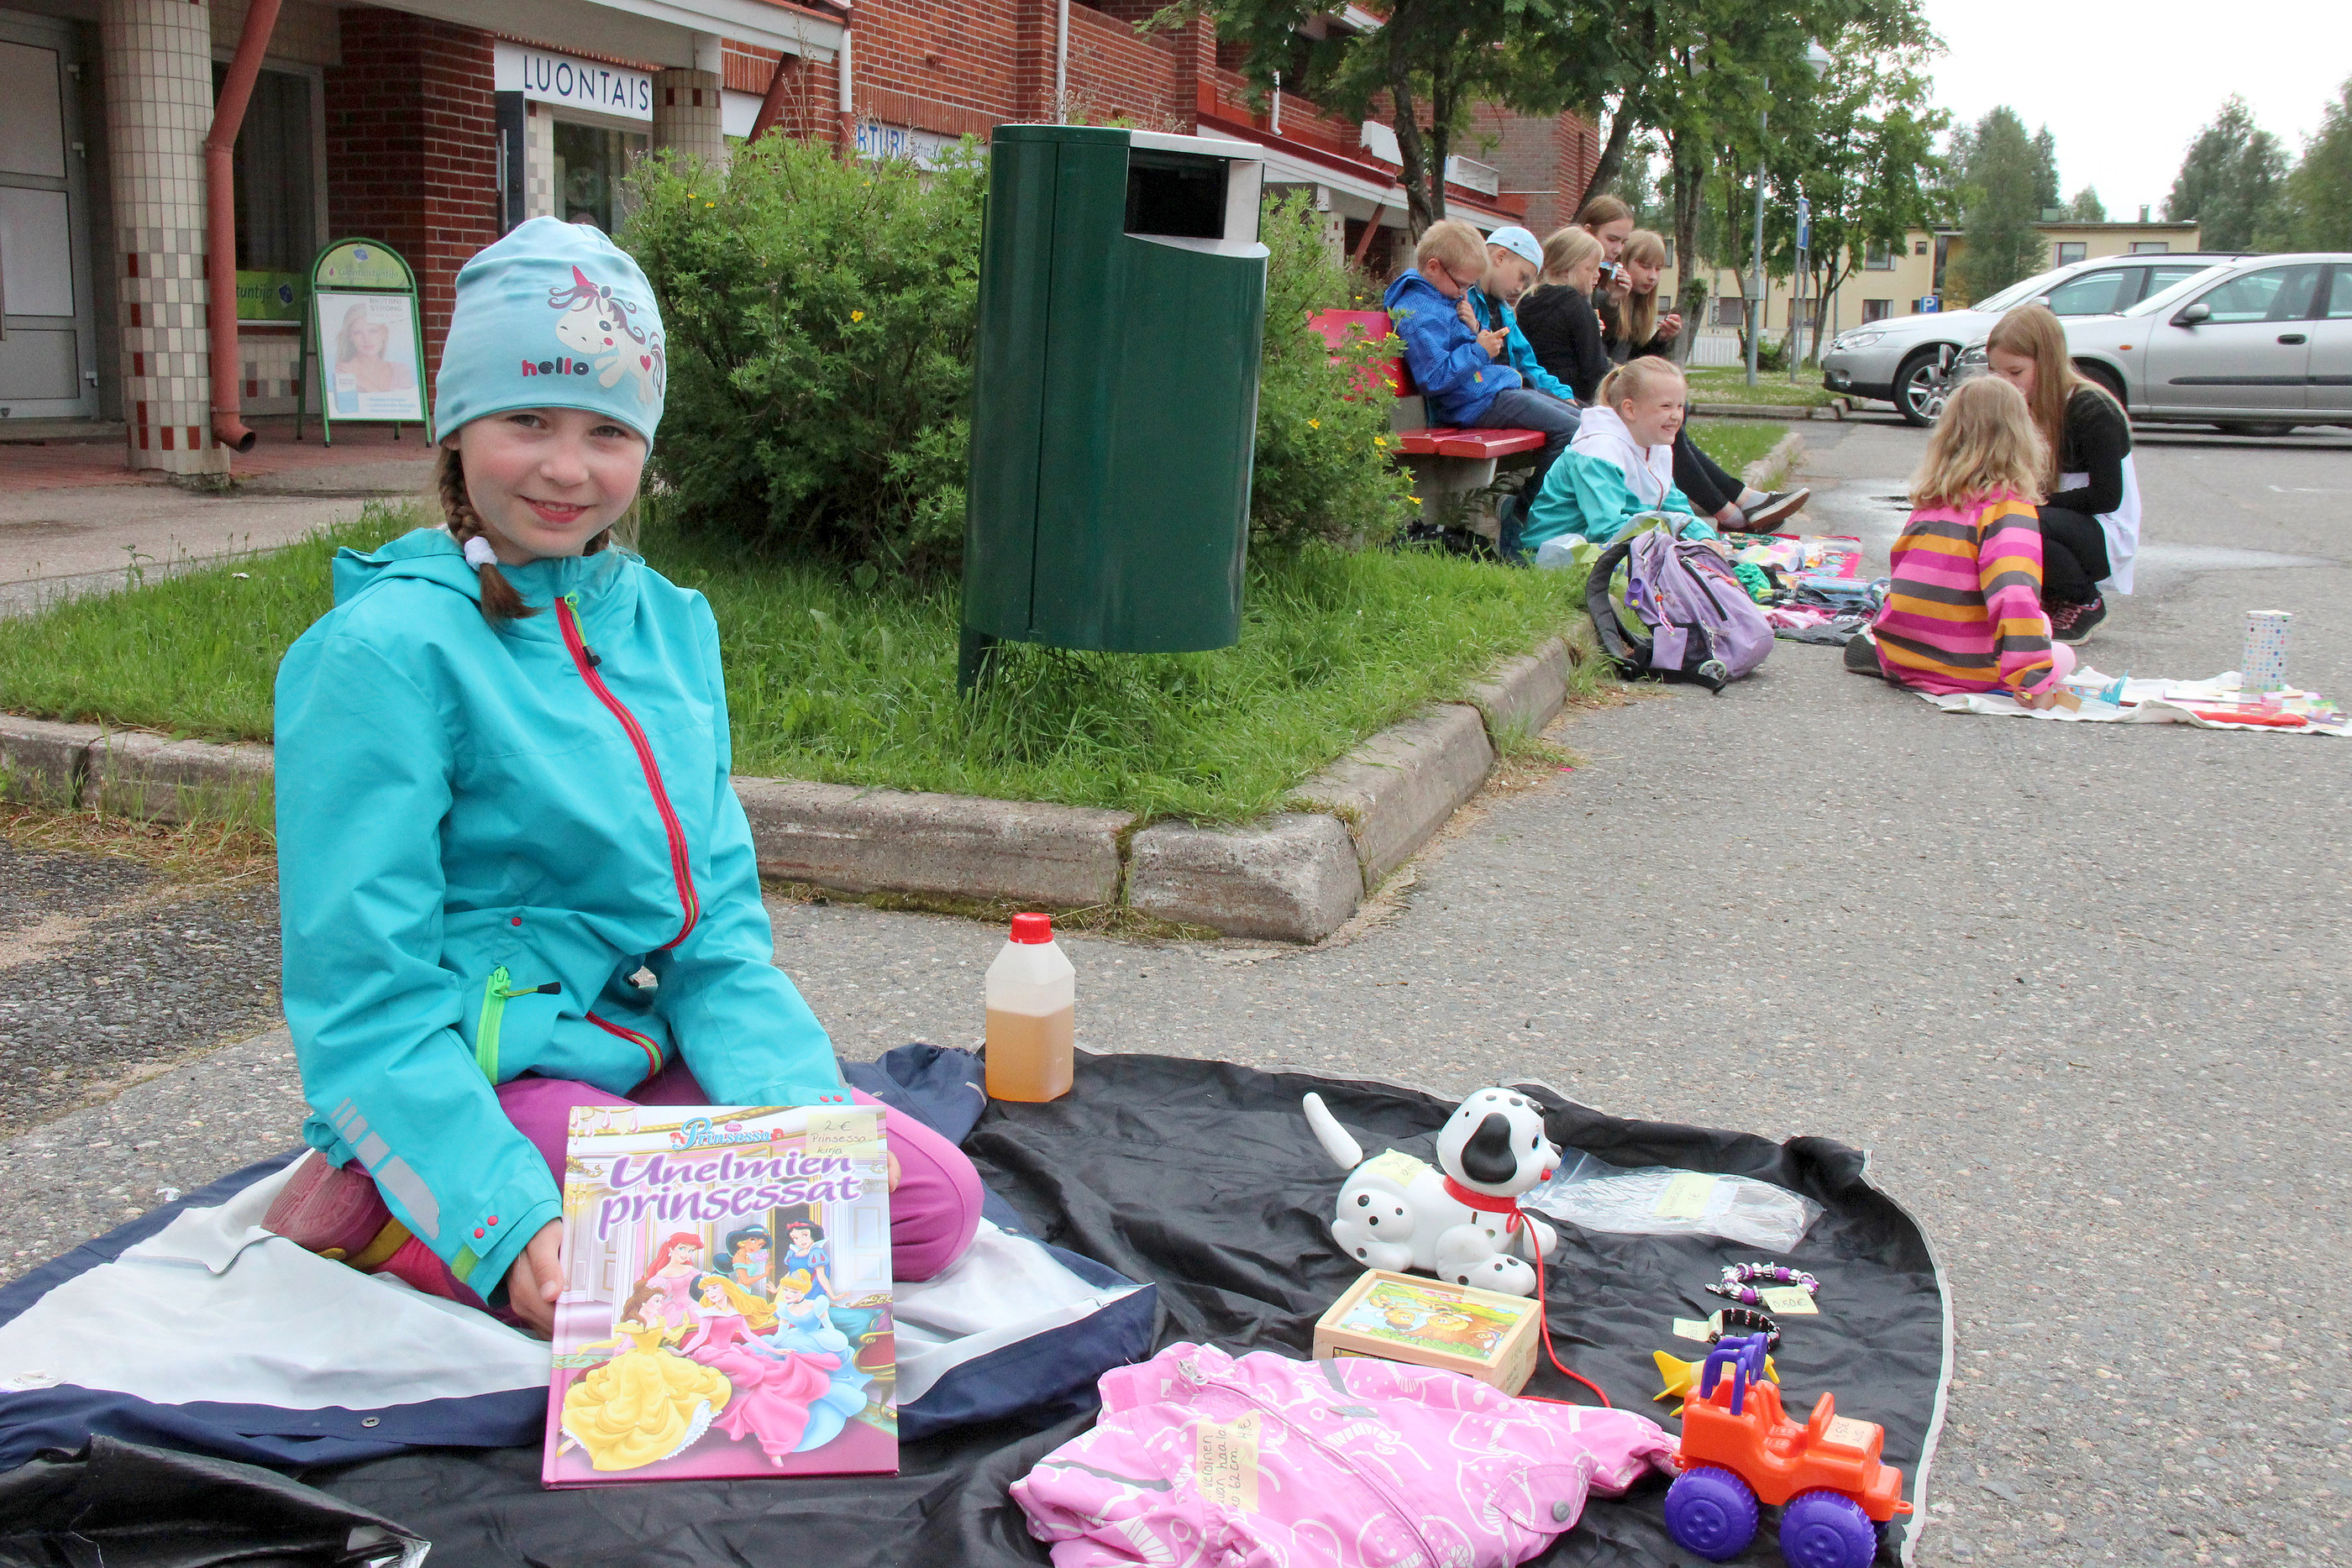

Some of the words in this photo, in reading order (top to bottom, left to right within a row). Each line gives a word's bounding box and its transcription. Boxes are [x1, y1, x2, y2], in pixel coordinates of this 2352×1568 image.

[524, 55, 648, 111] LUONTAIS
[1924, 297, 1935, 312] P
[522, 357, 590, 376] hello
[671, 1117, 772, 1151] Prinsessa
[817, 1146, 843, 1157] kirja
[610, 1151, 853, 1190] Unelmien
[598, 1177, 860, 1240] prinsessat
